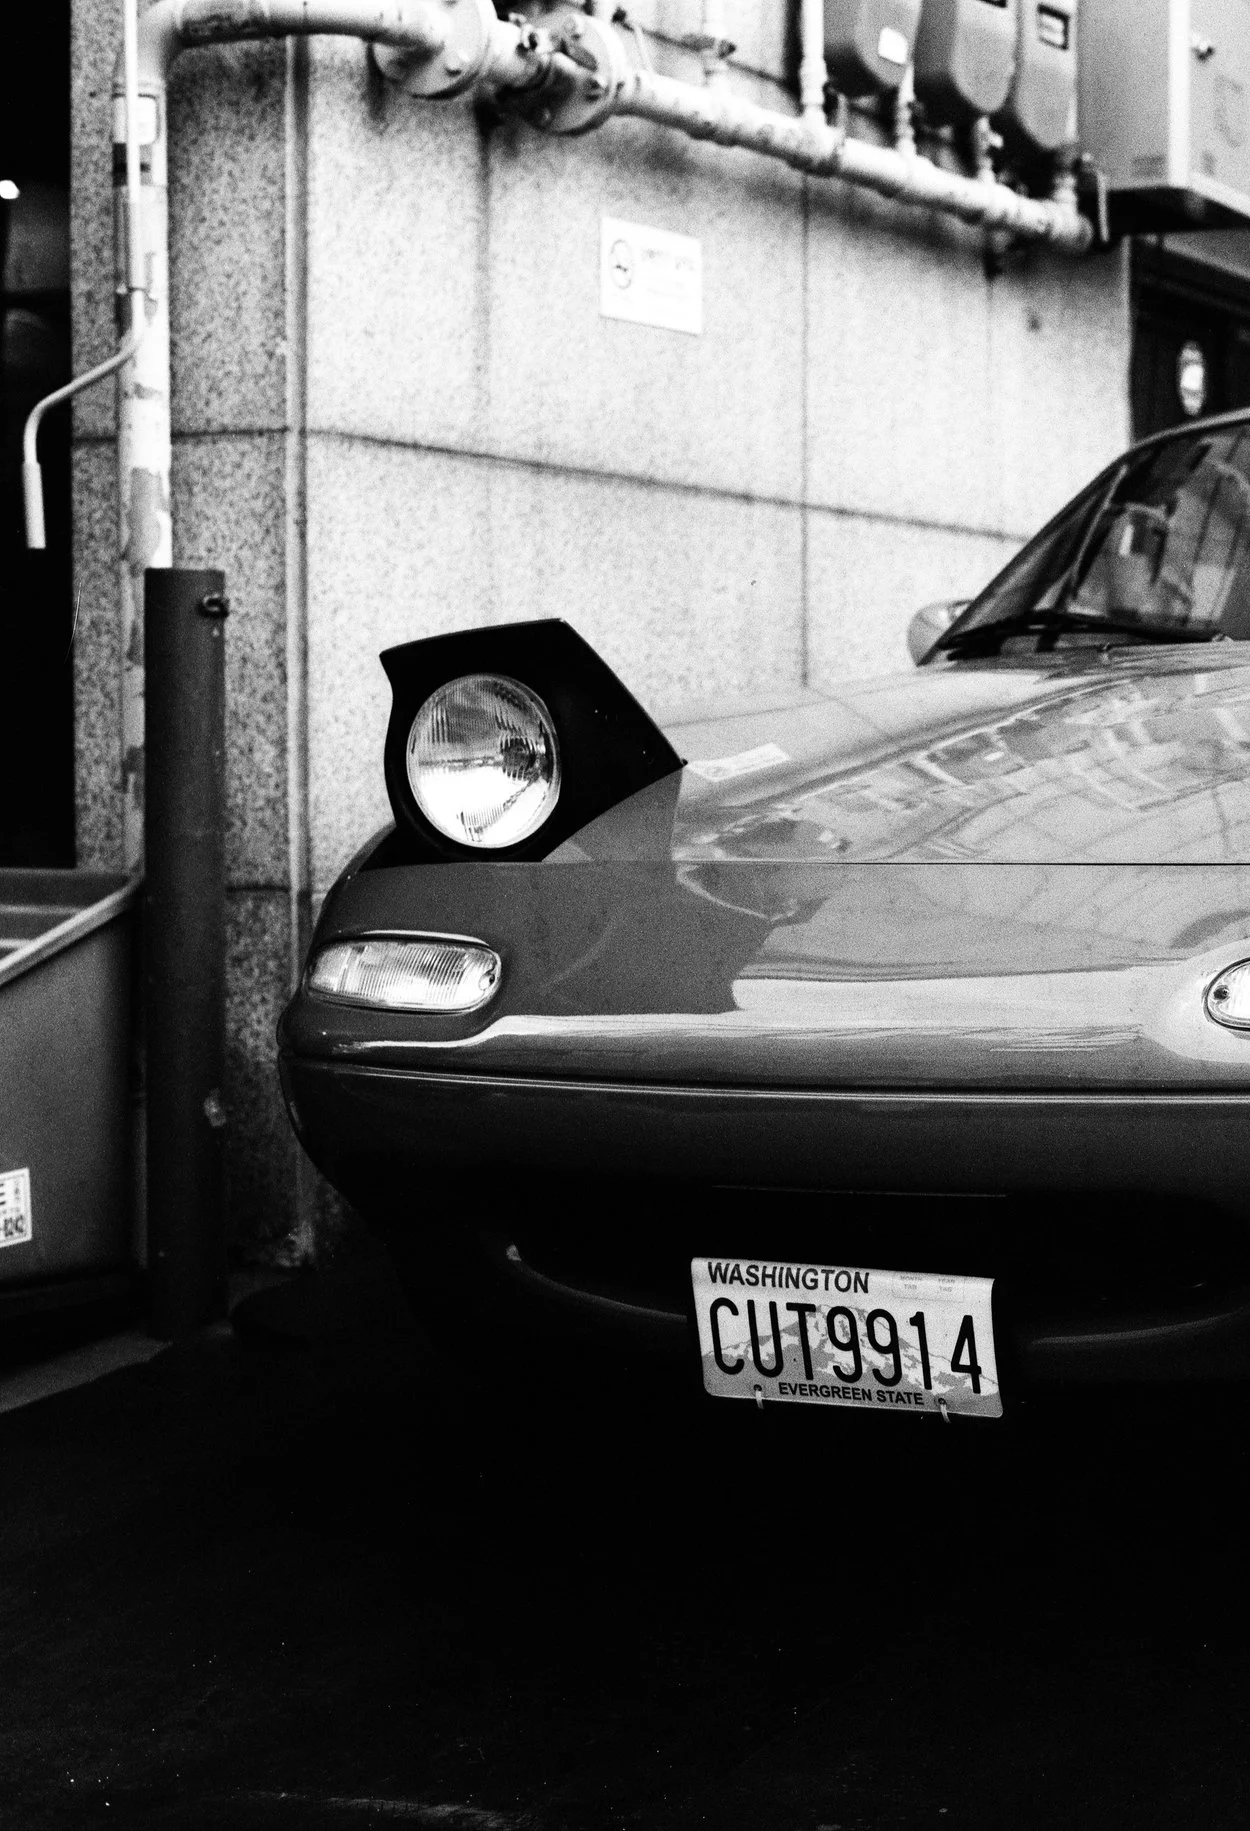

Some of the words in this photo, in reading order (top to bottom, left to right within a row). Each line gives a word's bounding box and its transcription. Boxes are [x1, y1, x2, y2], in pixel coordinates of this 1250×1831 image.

[707, 1262, 870, 1294] WASHINGTON
[709, 1297, 982, 1394] CUT9914
[778, 1382, 873, 1402] EVERGREEN
[876, 1390, 925, 1406] STATE
